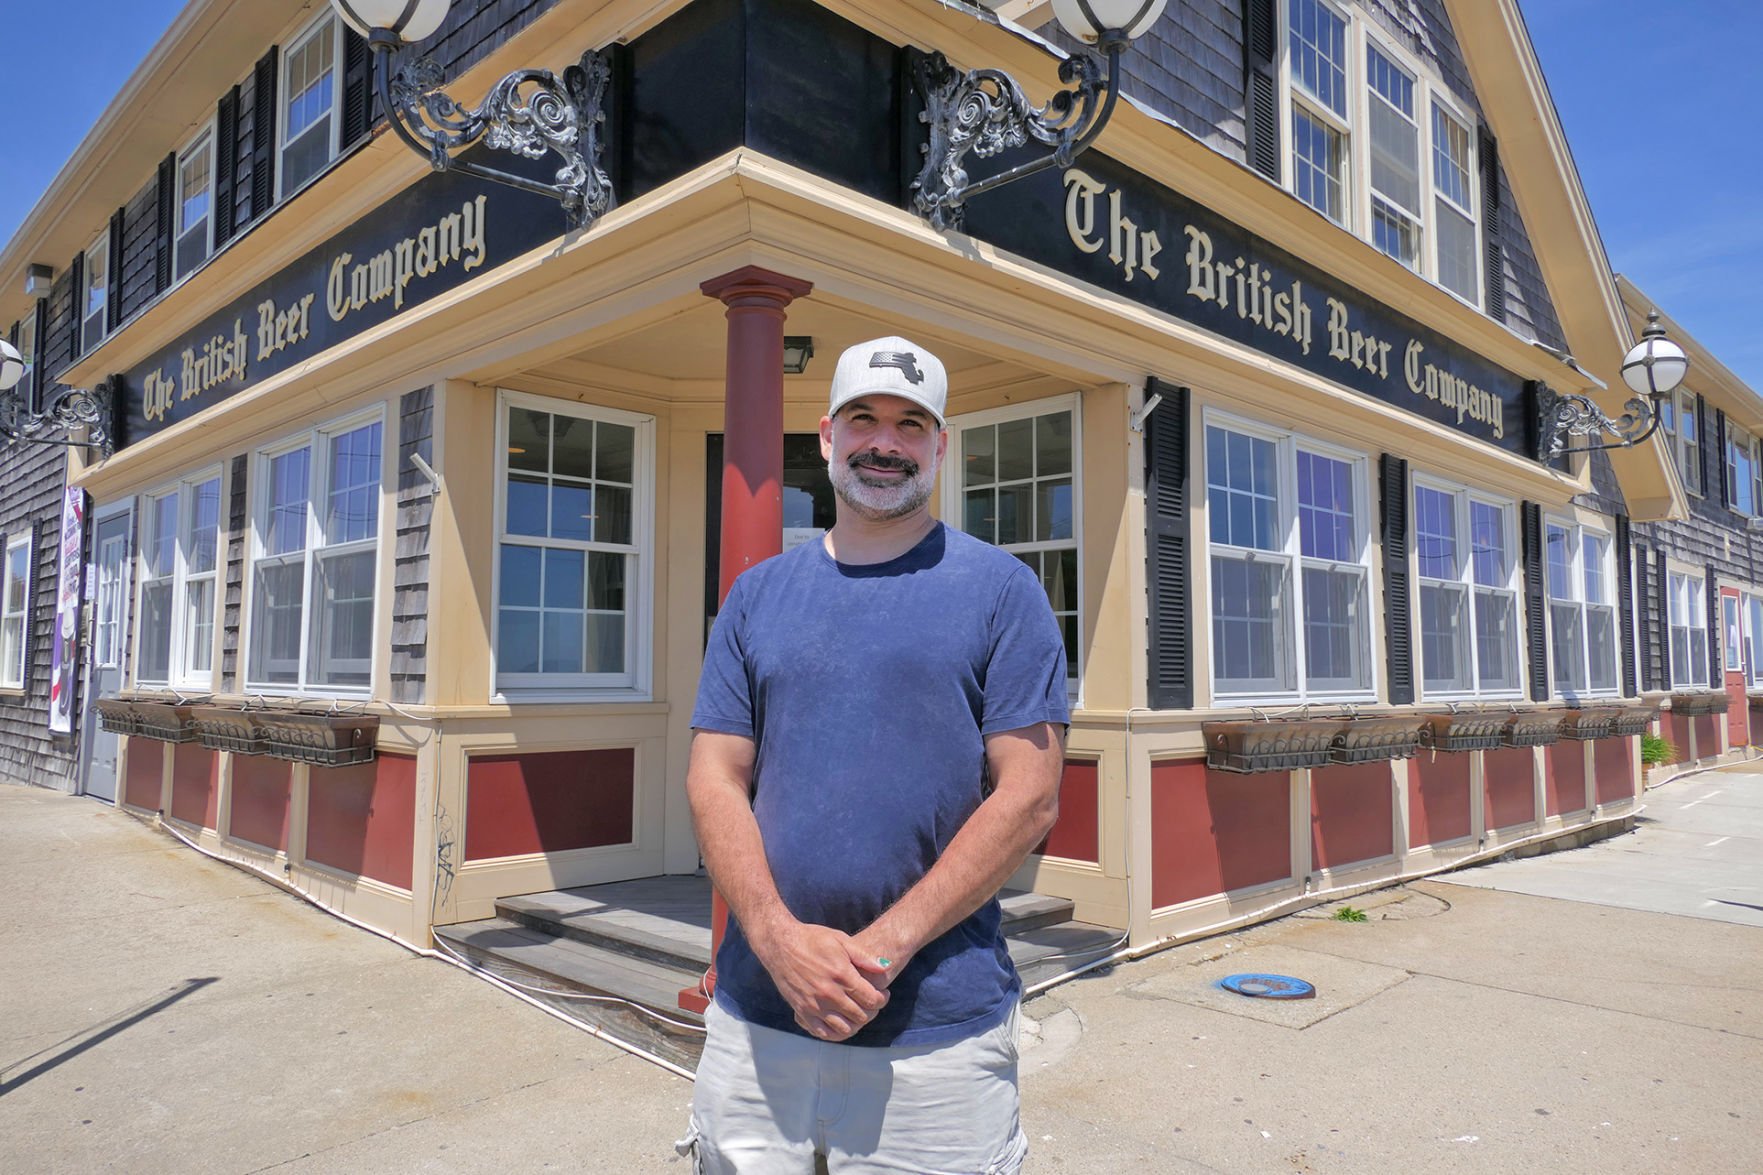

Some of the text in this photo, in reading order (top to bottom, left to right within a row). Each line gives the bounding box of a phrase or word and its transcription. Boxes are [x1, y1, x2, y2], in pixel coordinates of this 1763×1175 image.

[143, 194, 486, 422] The British Beer Company
[1063, 168, 1504, 439] The British Beer Company
